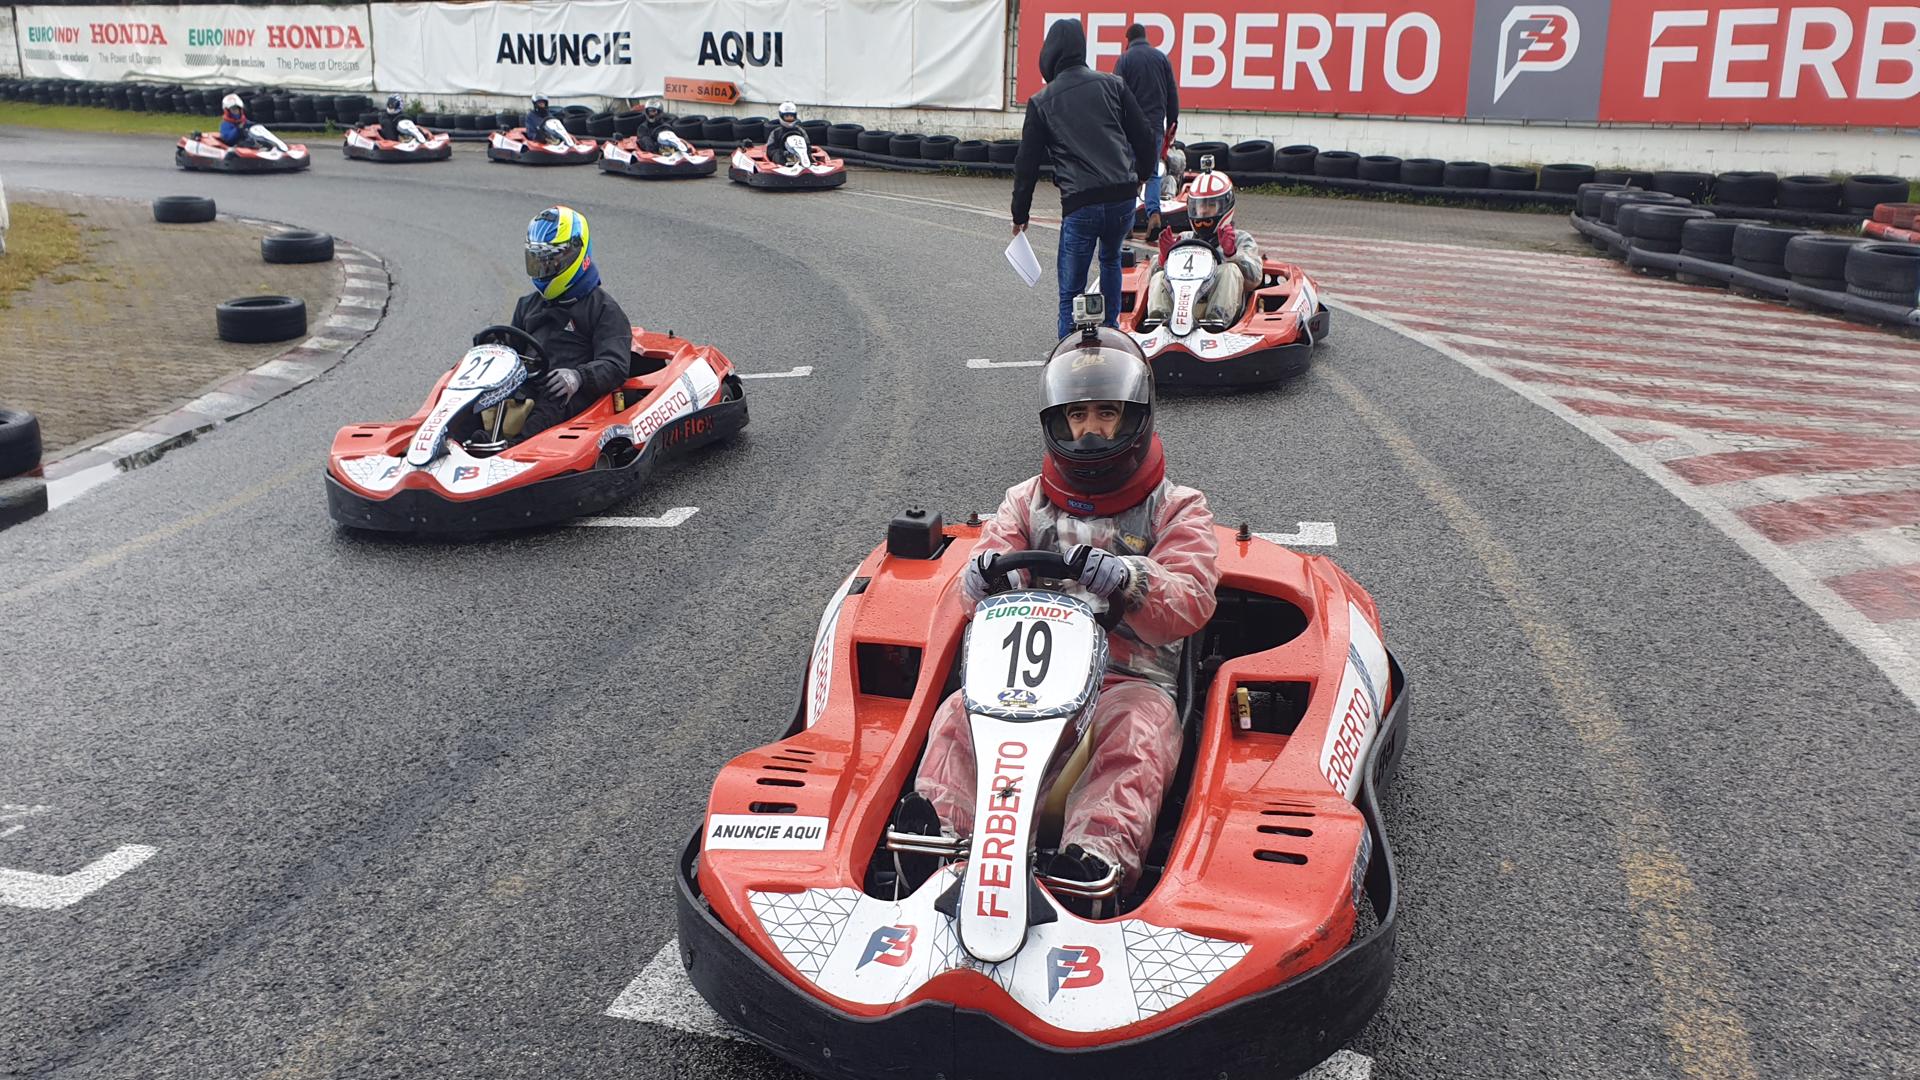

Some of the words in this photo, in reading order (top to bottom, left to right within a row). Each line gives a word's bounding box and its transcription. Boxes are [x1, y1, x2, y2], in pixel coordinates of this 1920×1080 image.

[29, 26, 80, 43] EUROINDY
[89, 23, 168, 45] HONDA
[188, 28, 256, 47] EUROINDY
[266, 24, 365, 49] HONDA
[496, 31, 632, 66] ANUNCIE
[697, 31, 783, 69] AQUI
[1042, 11, 1442, 95] EBERTO
[1643, 6, 1920, 100] FERB
[277, 57, 292, 70] The
[293, 58, 317, 71] Power
[318, 58, 326, 71] of
[328, 59, 360, 71] Dreams
[665, 83, 688, 94] EXIT
[697, 84, 728, 97] SAÍDA
[1183, 254, 1194, 273] 4
[457, 356, 497, 381] 21
[634, 391, 688, 441] FERBERTO
[985, 605, 1074, 620] EUROINDY
[1002, 620, 1053, 688] 19
[711, 824, 781, 839] ANUNCIE
[782, 825, 821, 840] AQUI
[976, 741, 1028, 919] FERBERTO
